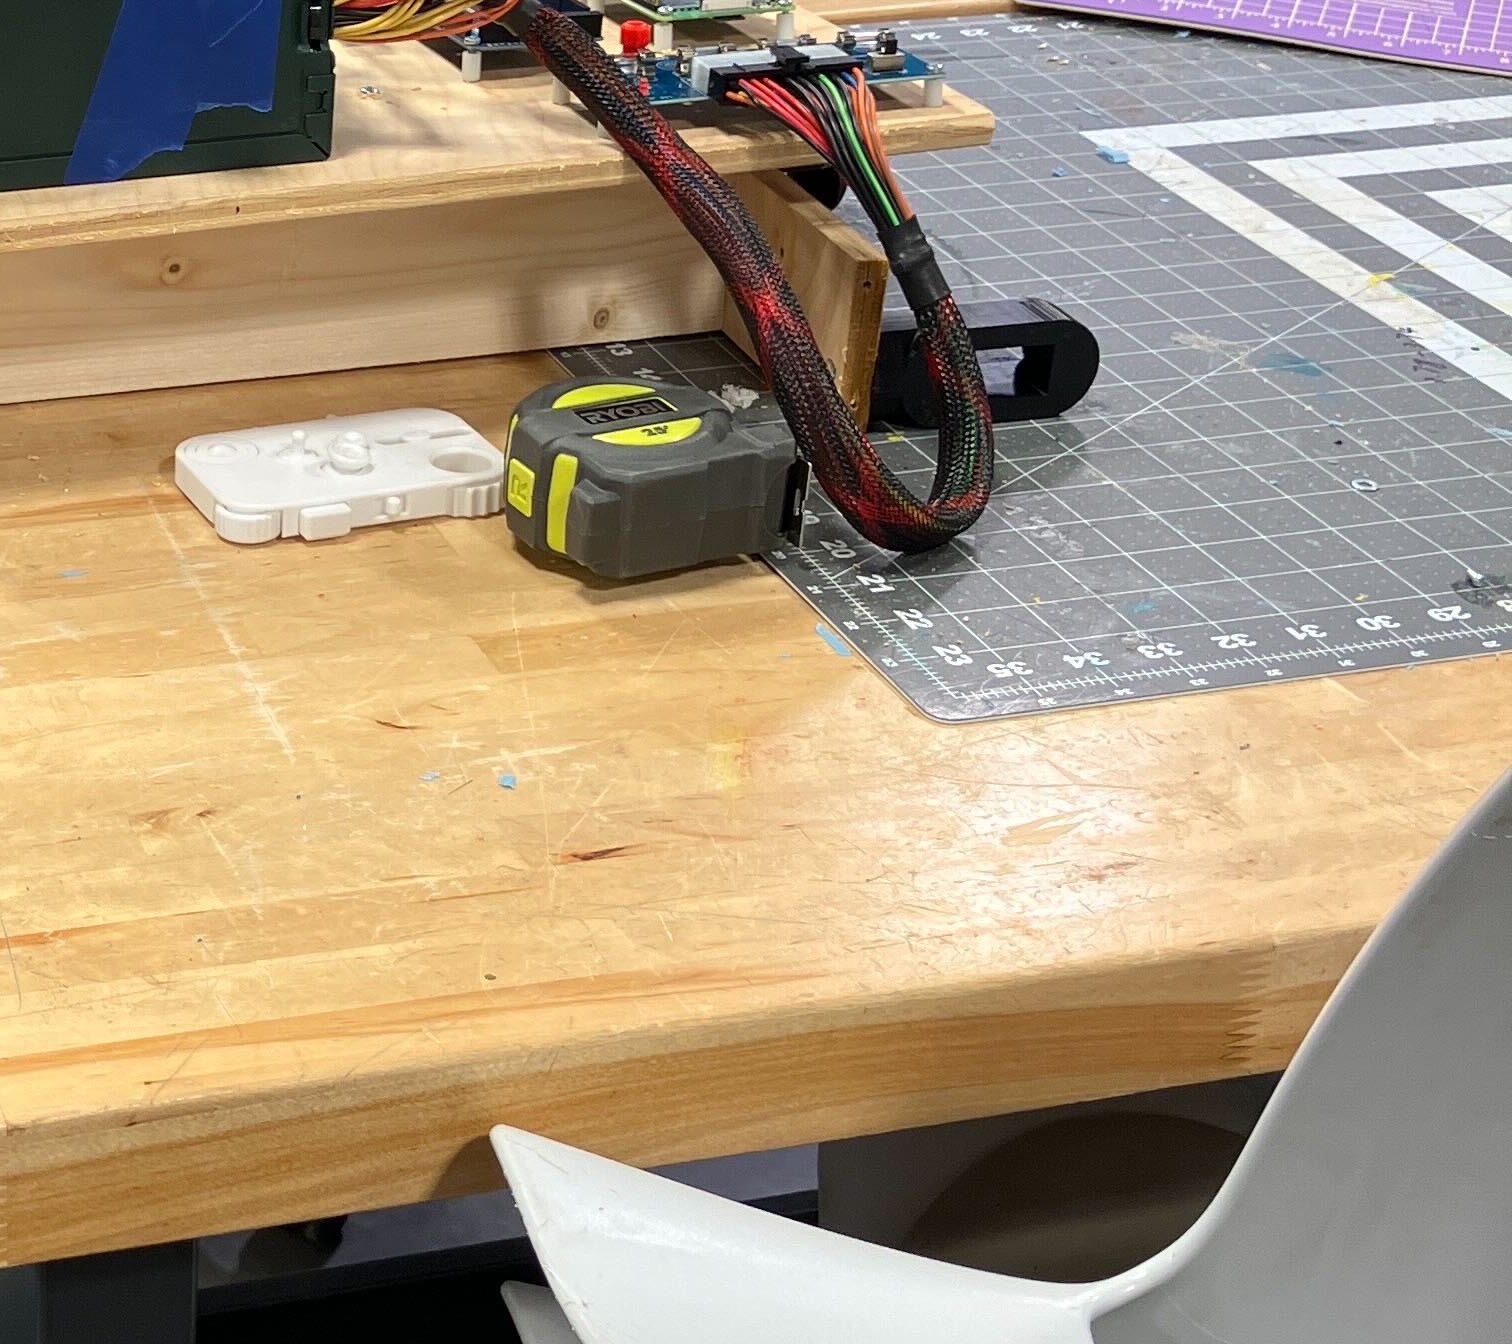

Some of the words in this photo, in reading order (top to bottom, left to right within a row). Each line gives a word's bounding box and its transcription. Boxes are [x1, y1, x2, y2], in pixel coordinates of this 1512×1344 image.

[605, 343, 633, 357] 13
[580, 400, 668, 425] RYOBI
[819, 539, 857, 559] 20
[856, 574, 896, 593] 21
[893, 608, 934, 631] 22
[1427, 605, 1472, 622] 29
[1355, 615, 1401, 631] 30
[1285, 624, 1328, 640] 31
[1210, 633, 1257, 649] 32
[931, 644, 974, 666] 23
[1137, 642, 1184, 659] 33
[1063, 651, 1111, 669] 34
[987, 661, 1034, 678] 35
